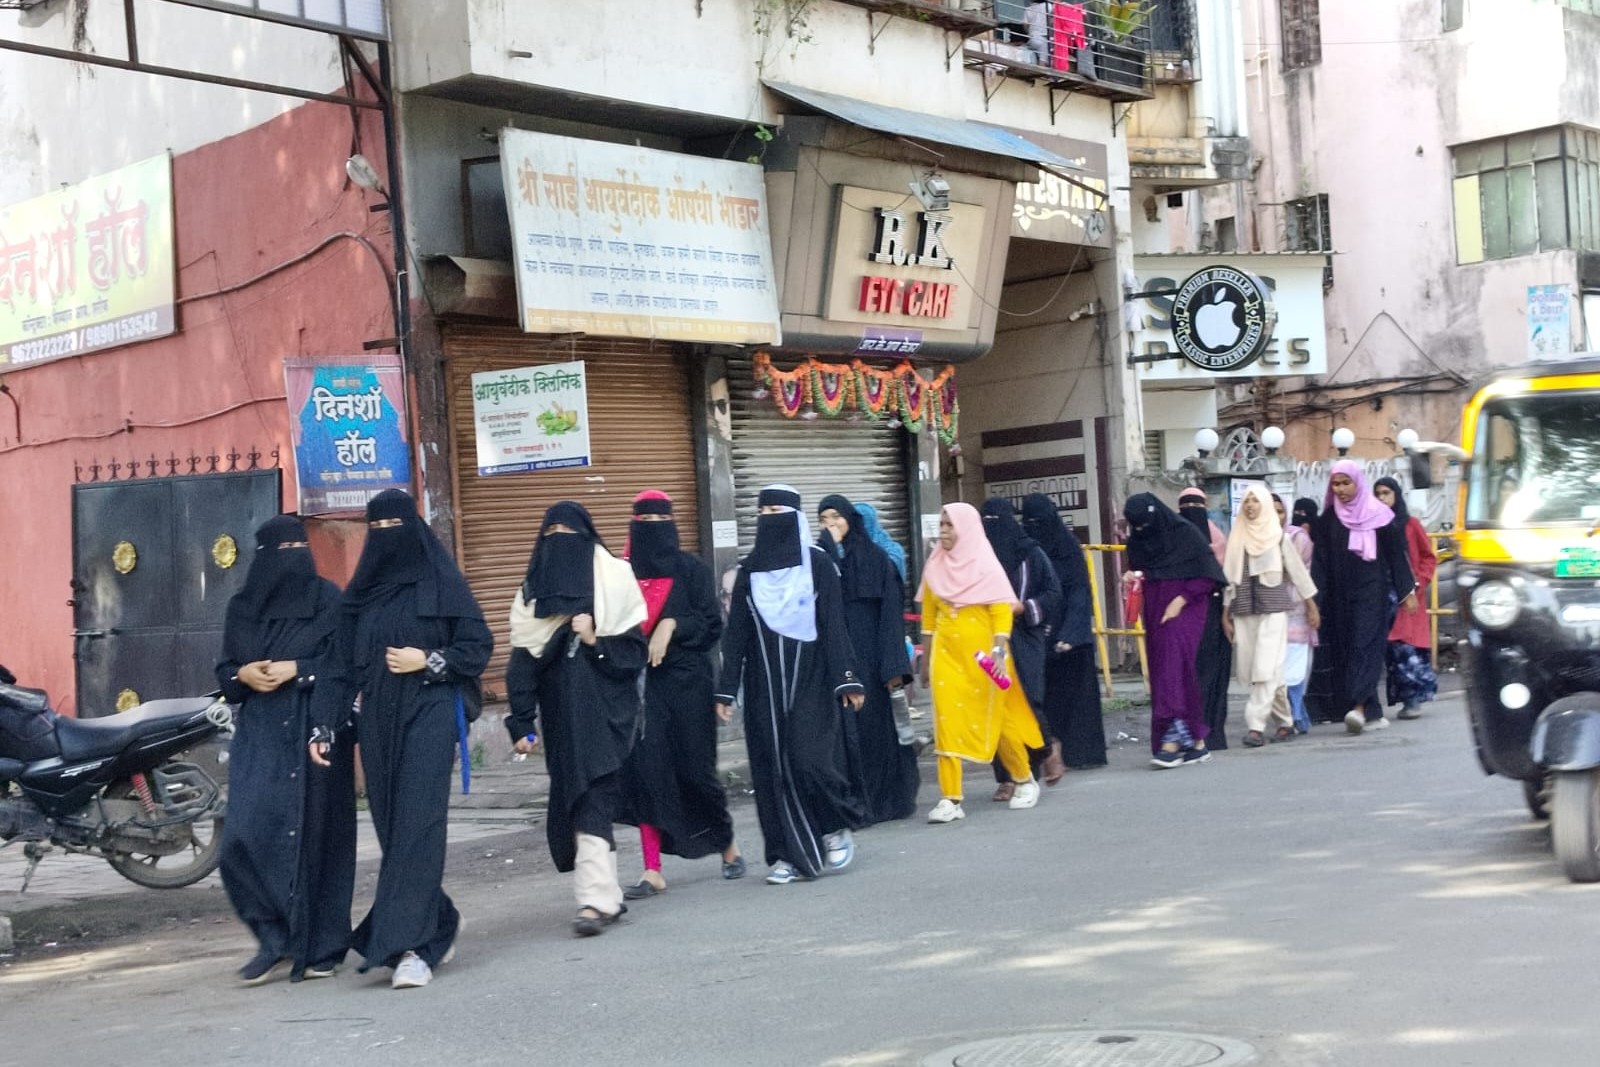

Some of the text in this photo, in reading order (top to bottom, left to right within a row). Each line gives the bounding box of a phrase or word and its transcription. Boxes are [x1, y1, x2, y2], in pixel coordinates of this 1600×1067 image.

[517, 157, 539, 206] श्री
[543, 163, 579, 218] साई
[85, 185, 148, 291] हॉल
[903, 279, 958, 319] CARE
[1176, 271, 1210, 311] PREMIUM
[1212, 270, 1255, 299] RESELLER
[1179, 333, 1209, 364] CLASSIC
[1210, 321, 1262, 366] ENTERPRISES
[534, 370, 582, 393] क्लिनिक
[312, 386, 382, 422] दिनशॉ
[334, 430, 376, 466] हॉल
